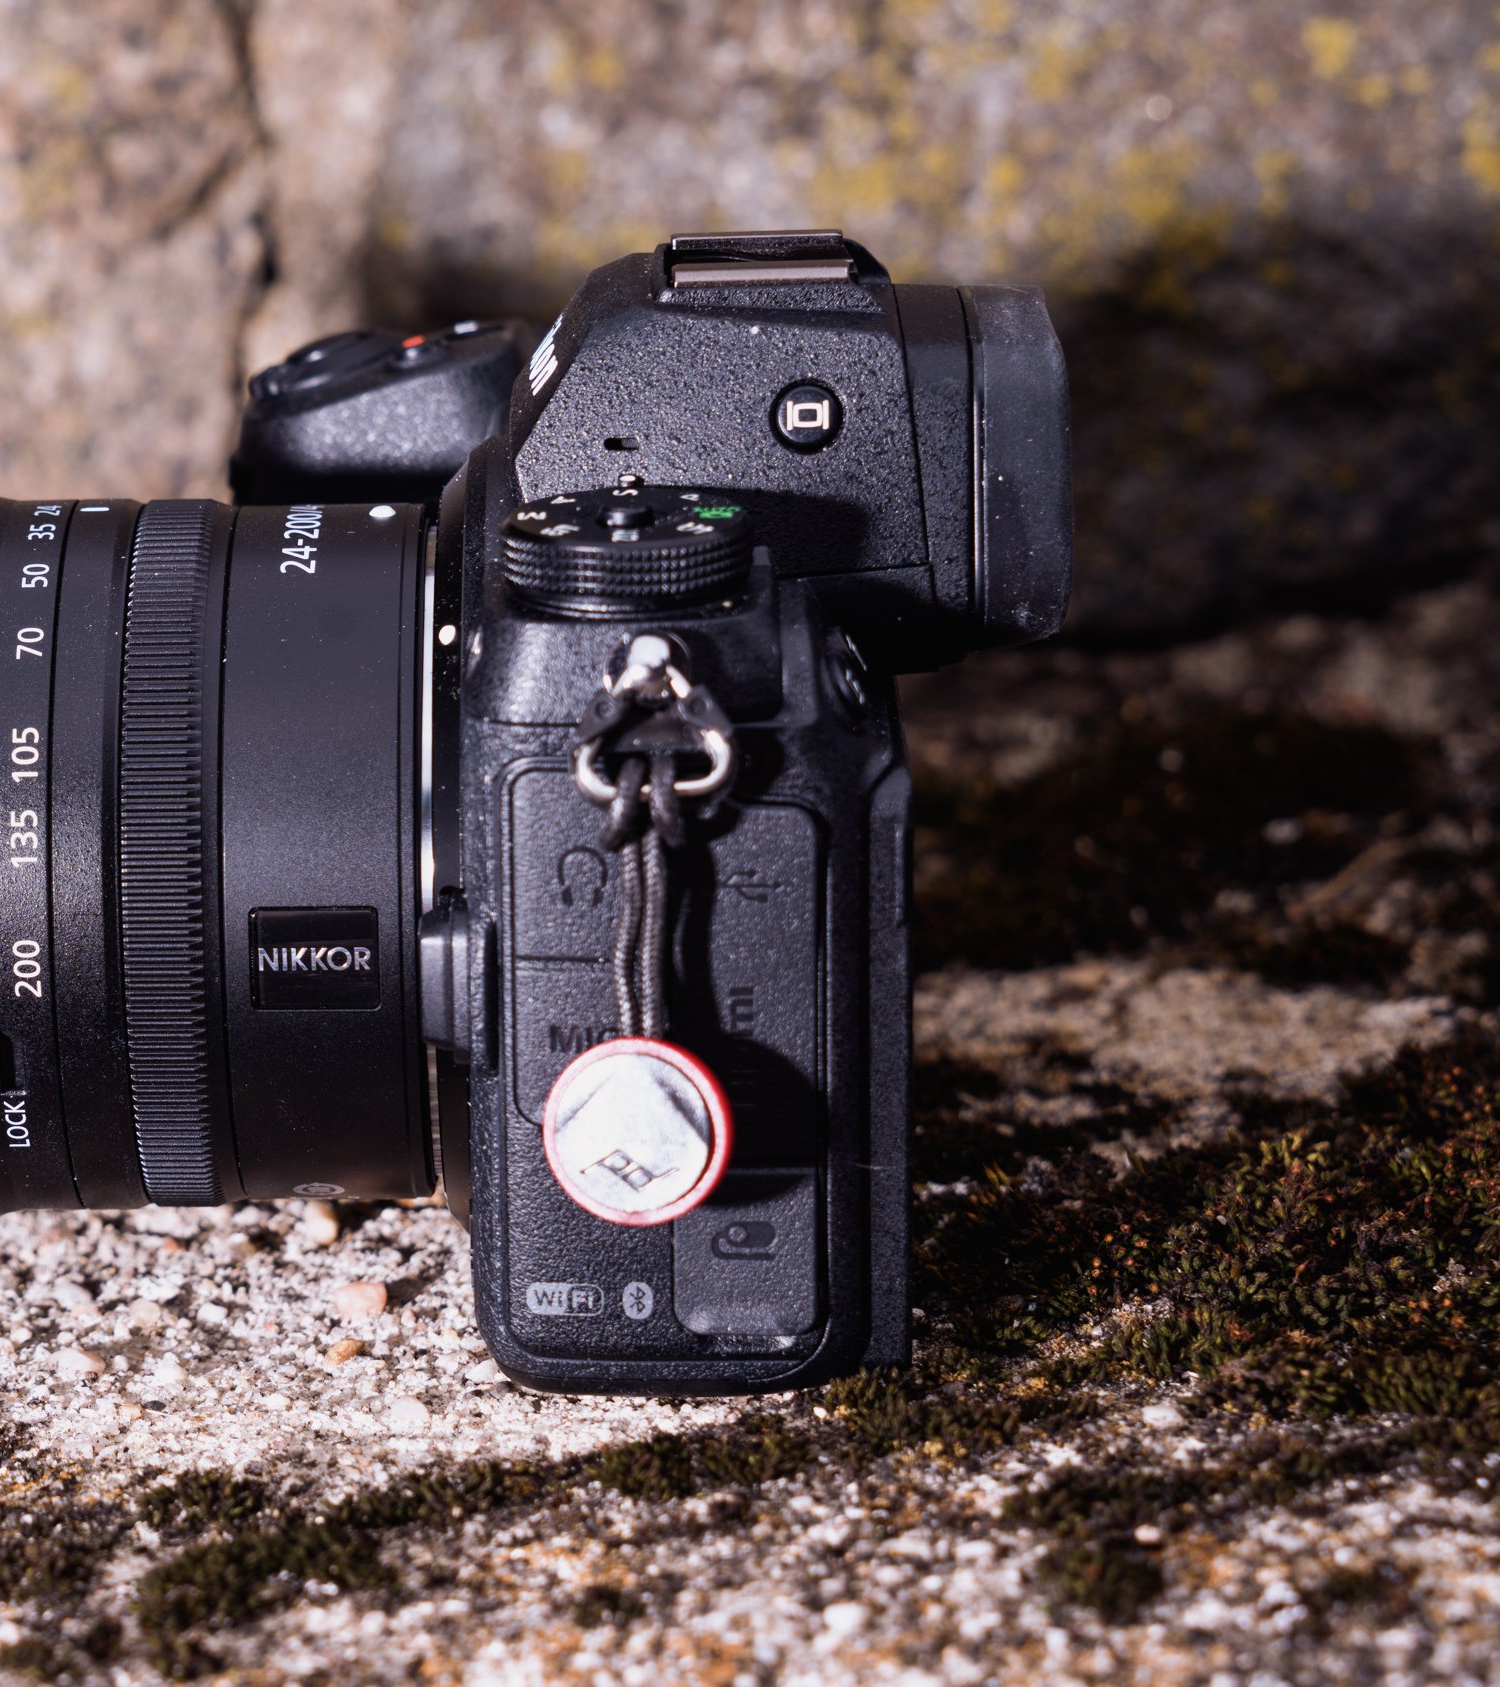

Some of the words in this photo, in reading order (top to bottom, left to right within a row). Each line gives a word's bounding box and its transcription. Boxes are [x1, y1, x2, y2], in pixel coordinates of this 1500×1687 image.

[33, 505, 63, 517] 24
[27, 523, 57, 541] 35
[21, 563, 50, 589] 50
[15, 627, 45, 660] 70
[11, 727, 40, 783] 105
[10, 809, 39, 868] 135
[12, 939, 43, 998] 200
[257, 946, 372, 972] NIKKOR
[3, 1100, 31, 1149] LOCK
